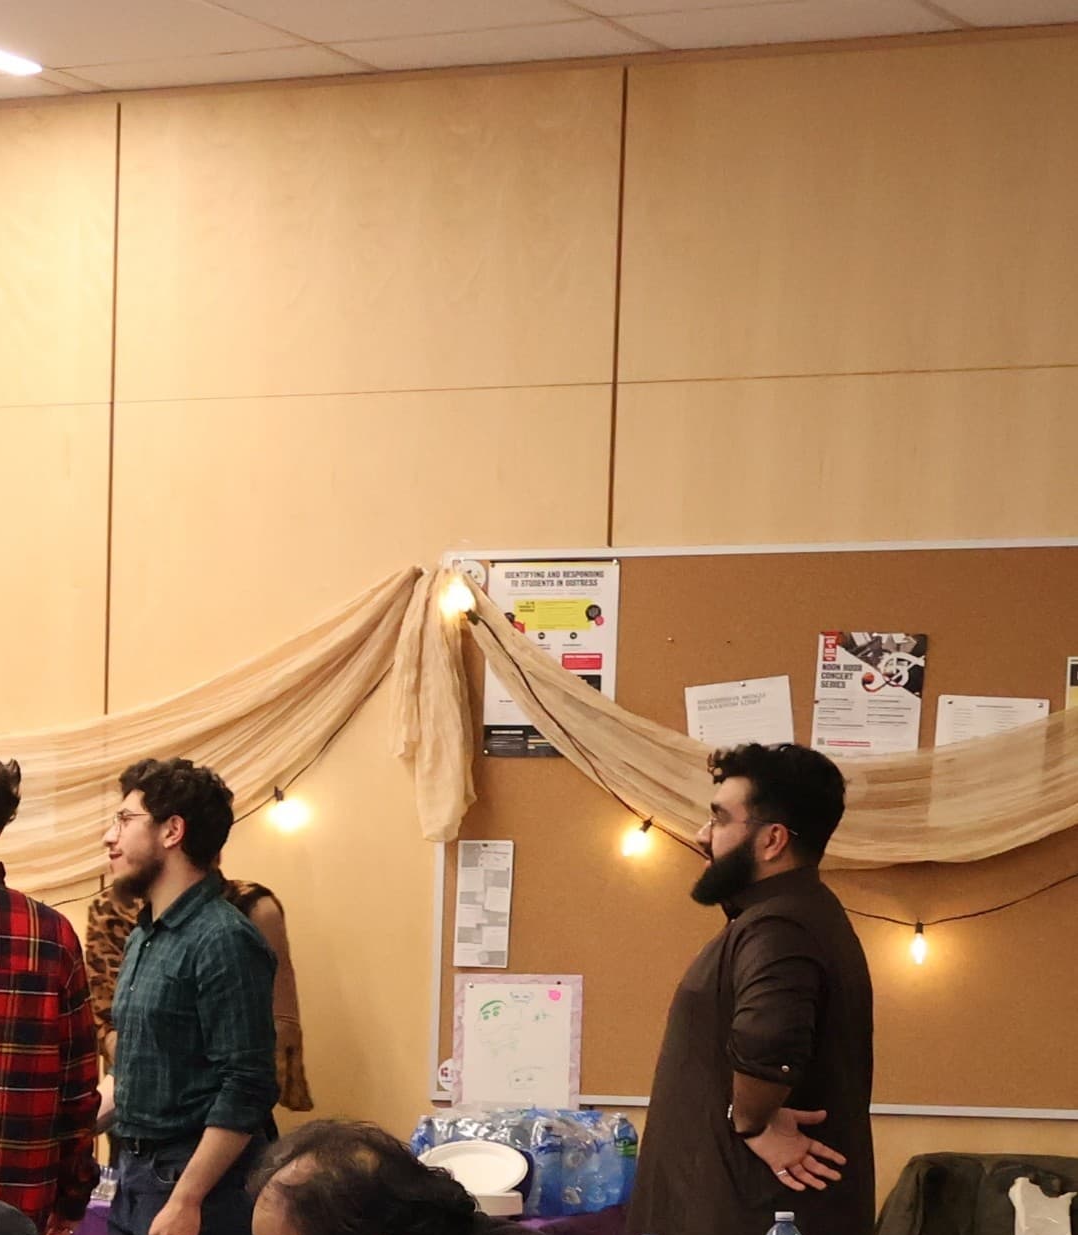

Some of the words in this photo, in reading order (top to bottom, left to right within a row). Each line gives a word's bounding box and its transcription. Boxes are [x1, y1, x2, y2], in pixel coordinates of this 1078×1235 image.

[505, 570, 545, 579] IDENTIFYING
[547, 570, 560, 578] AND
[520, 579, 554, 587] STUDENTS
